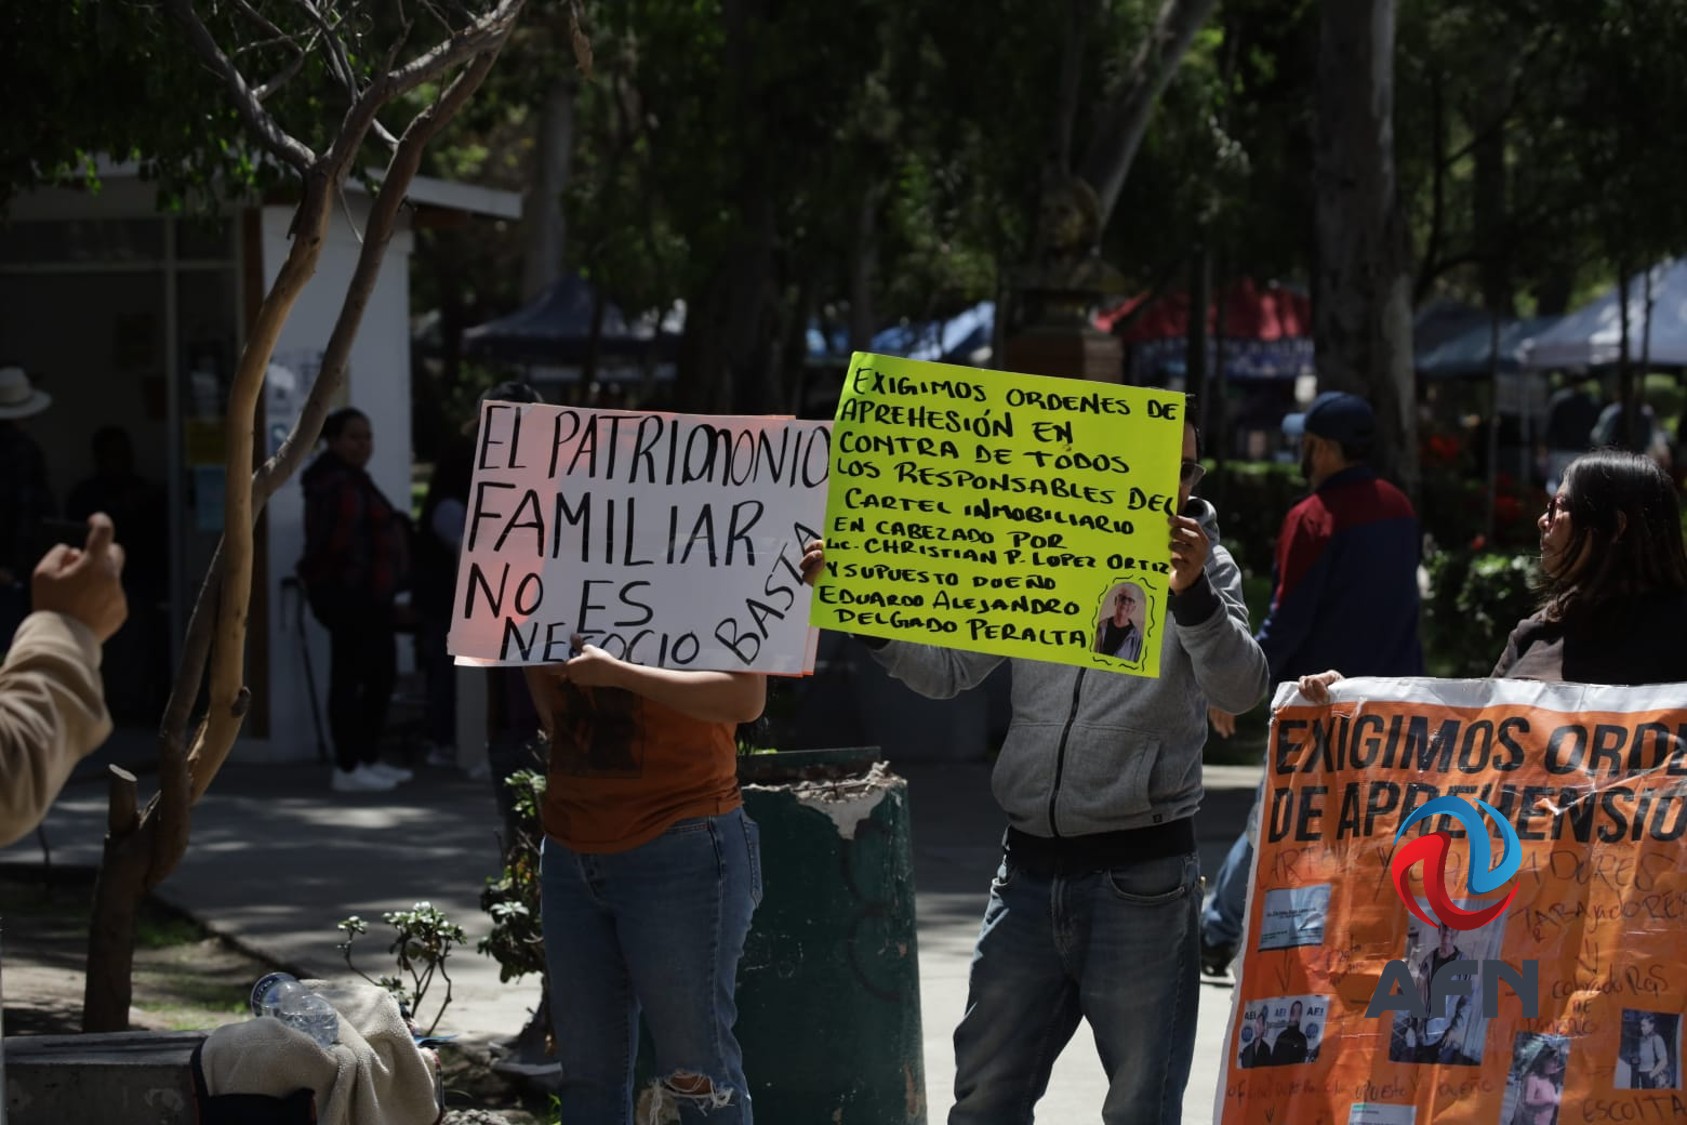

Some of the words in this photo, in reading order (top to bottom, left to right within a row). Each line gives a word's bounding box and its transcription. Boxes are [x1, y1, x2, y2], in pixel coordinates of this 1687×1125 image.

[853, 367, 987, 402] EXIGIMOS
[1005, 388, 1131, 415] ORDENES
[1147, 399, 1178, 421] DE
[478, 404, 526, 471] EL
[840, 397, 1013, 438] APREHESIÓN
[1031, 421, 1074, 445] EN
[839, 430, 959, 459] CONTRA
[975, 444, 1012, 465] DE
[1023, 450, 1130, 474] TODOS
[837, 457, 881, 479] LOS
[893, 461, 1115, 505] RESPONSABLES
[1128, 488, 1174, 516] DEL
[844, 487, 951, 514] CARTEL
[964, 498, 1134, 535] INMOBILIARIO
[467, 481, 764, 568] FAMILIAR
[834, 516, 865, 533] EN
[875, 520, 995, 544] CABEZADO
[1009, 531, 1067, 549] POR
[825, 561, 838, 578] Y
[843, 563, 959, 586] SUPUESTO
[864, 537, 997, 565] CHRISTIAN
[1032, 552, 1096, 568] LOPEZ
[1107, 554, 1170, 575] ORTIZ
[464, 562, 544, 619] NO
[576, 579, 654, 635] ES
[714, 521, 822, 665] BASTA
[819, 585, 924, 608] EDUARDO
[932, 590, 1080, 616] ALEJANDRO
[833, 608, 958, 633] DELGADO
[965, 618, 1087, 648] PERALTA
[1275, 714, 1530, 775] EXIGIMOS
[1267, 786, 1329, 844] DE
